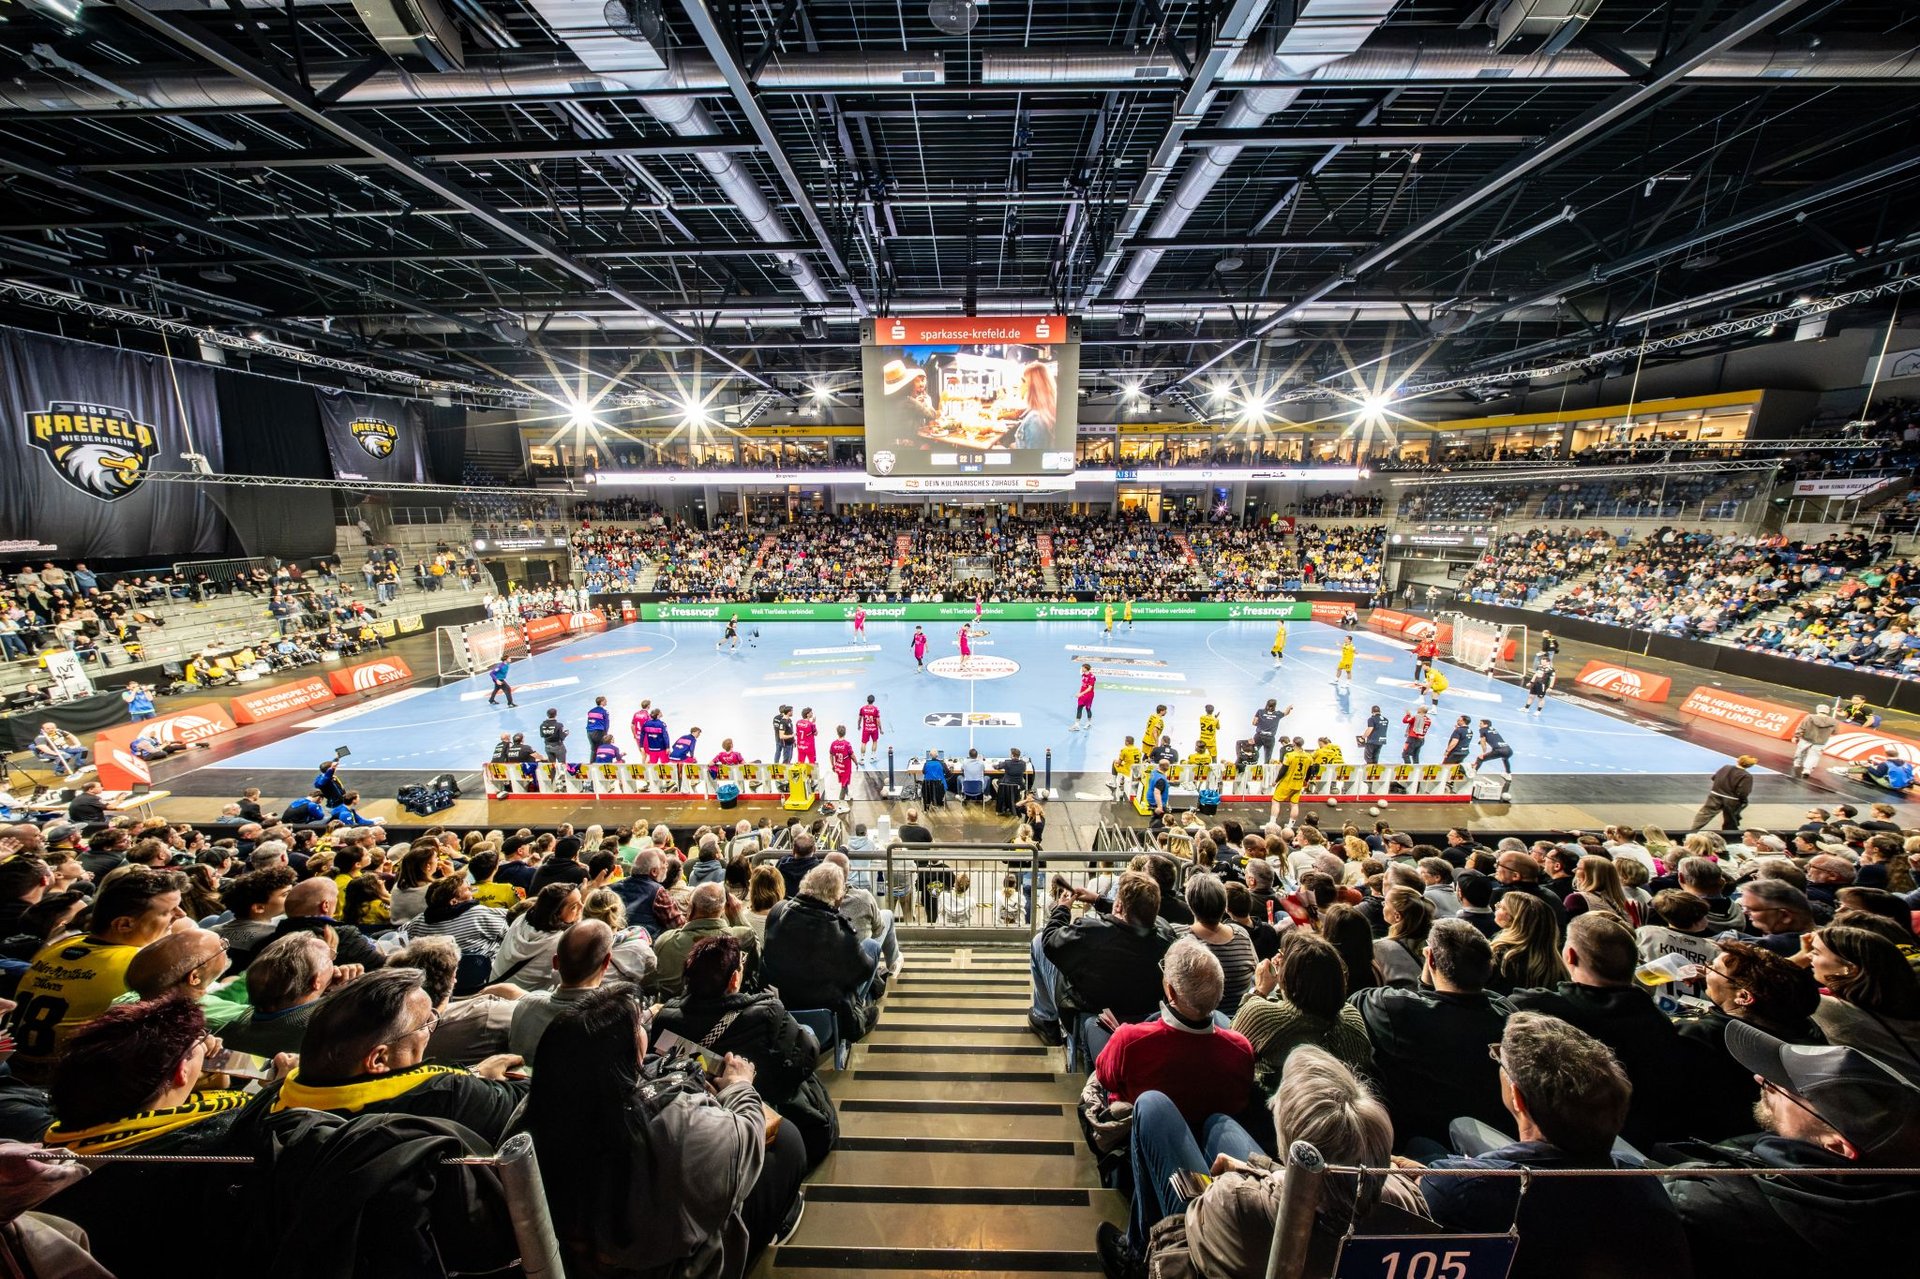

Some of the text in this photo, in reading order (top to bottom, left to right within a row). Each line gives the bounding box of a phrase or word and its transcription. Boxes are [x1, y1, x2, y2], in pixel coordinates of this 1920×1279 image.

[920, 329, 1021, 341] sparkasse-krefeld.de
[61, 434, 134, 447] NIEDERRHEIN
[671, 606, 720, 617] fressnapf
[860, 606, 907, 617] ressnapf
[1049, 606, 1100, 617] fressnapf
[1243, 605, 1294, 616] fressnapf
[57, 663, 75, 675] IVT
[378, 668, 408, 685] SWK
[1609, 681, 1645, 698] SWK
[253, 689, 330, 717] STROM UND GAS
[1693, 692, 1790, 725] IHR HEIMSPIEL FÜR
[1686, 700, 1782, 733] STROM UND GAS
[181, 721, 227, 743] SWK
[1200, 722, 1214, 733] 24
[1297, 762, 1304, 772] 3
[1660, 943, 1707, 965] KNORR
[1381, 1251, 1471, 1279] 105
